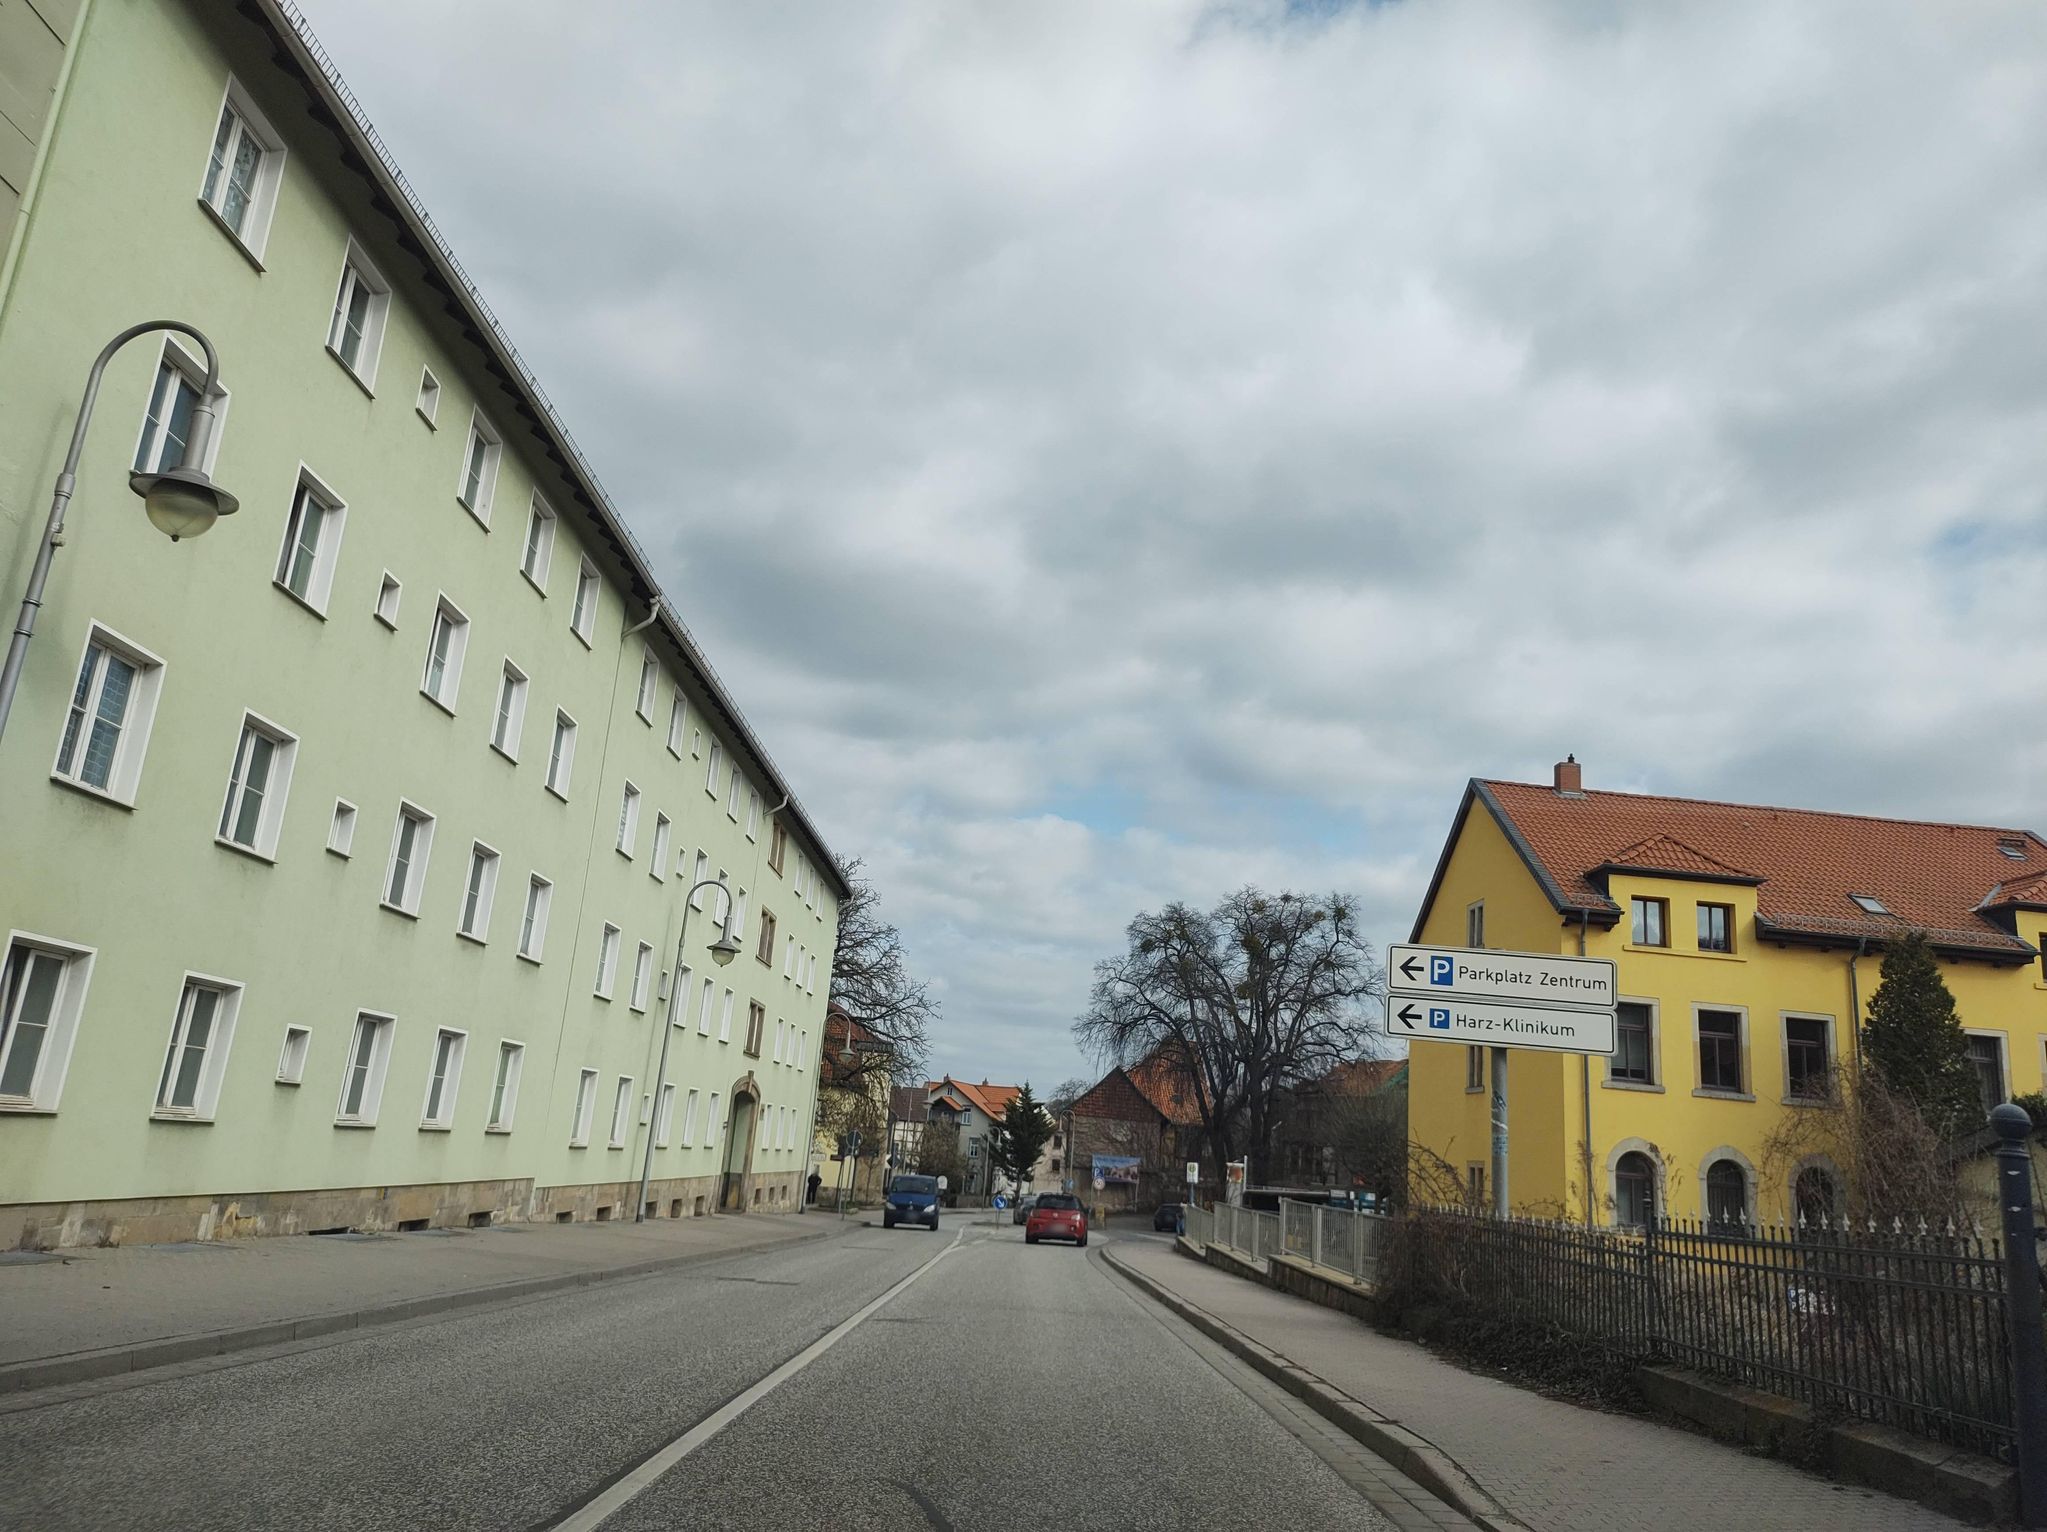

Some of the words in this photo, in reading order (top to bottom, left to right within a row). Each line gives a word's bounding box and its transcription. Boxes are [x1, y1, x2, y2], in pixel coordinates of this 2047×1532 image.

[1433, 959, 1450, 982] P
[1458, 965, 1532, 985] Parkplatz
[1540, 972, 1607, 990] Zentrum
[1433, 1010, 1445, 1026] P
[1456, 1013, 1575, 1037] Harz-Klinikum
